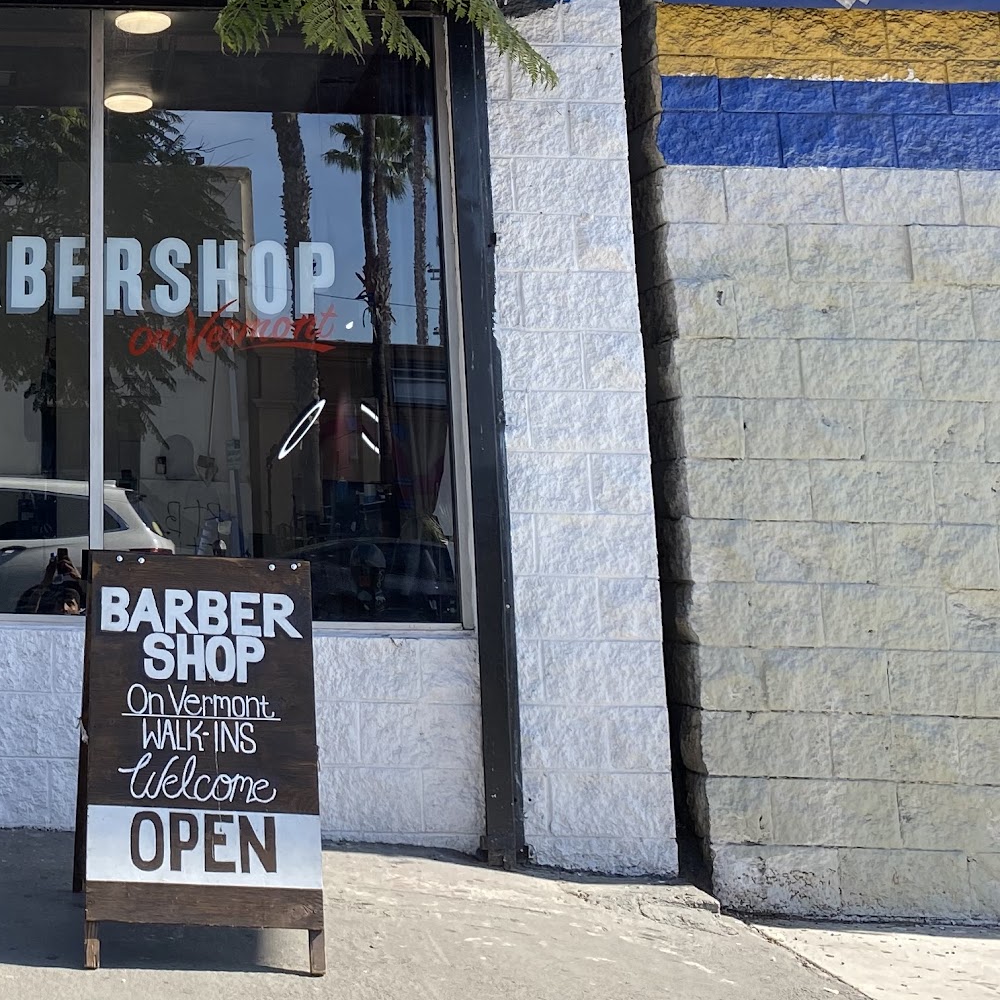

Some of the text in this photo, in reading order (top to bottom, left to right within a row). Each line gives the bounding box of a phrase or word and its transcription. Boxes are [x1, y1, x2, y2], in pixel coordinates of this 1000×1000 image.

[127, 298, 338, 369] on Vermont
[100, 586, 303, 639] BARBER
[142, 632, 266, 683] SHOP
[126, 683, 276, 719] On Vermont
[142, 718, 257, 754] WALK-INS
[118, 752, 277, 804] Welcome
[130, 811, 278, 874] OPEN
